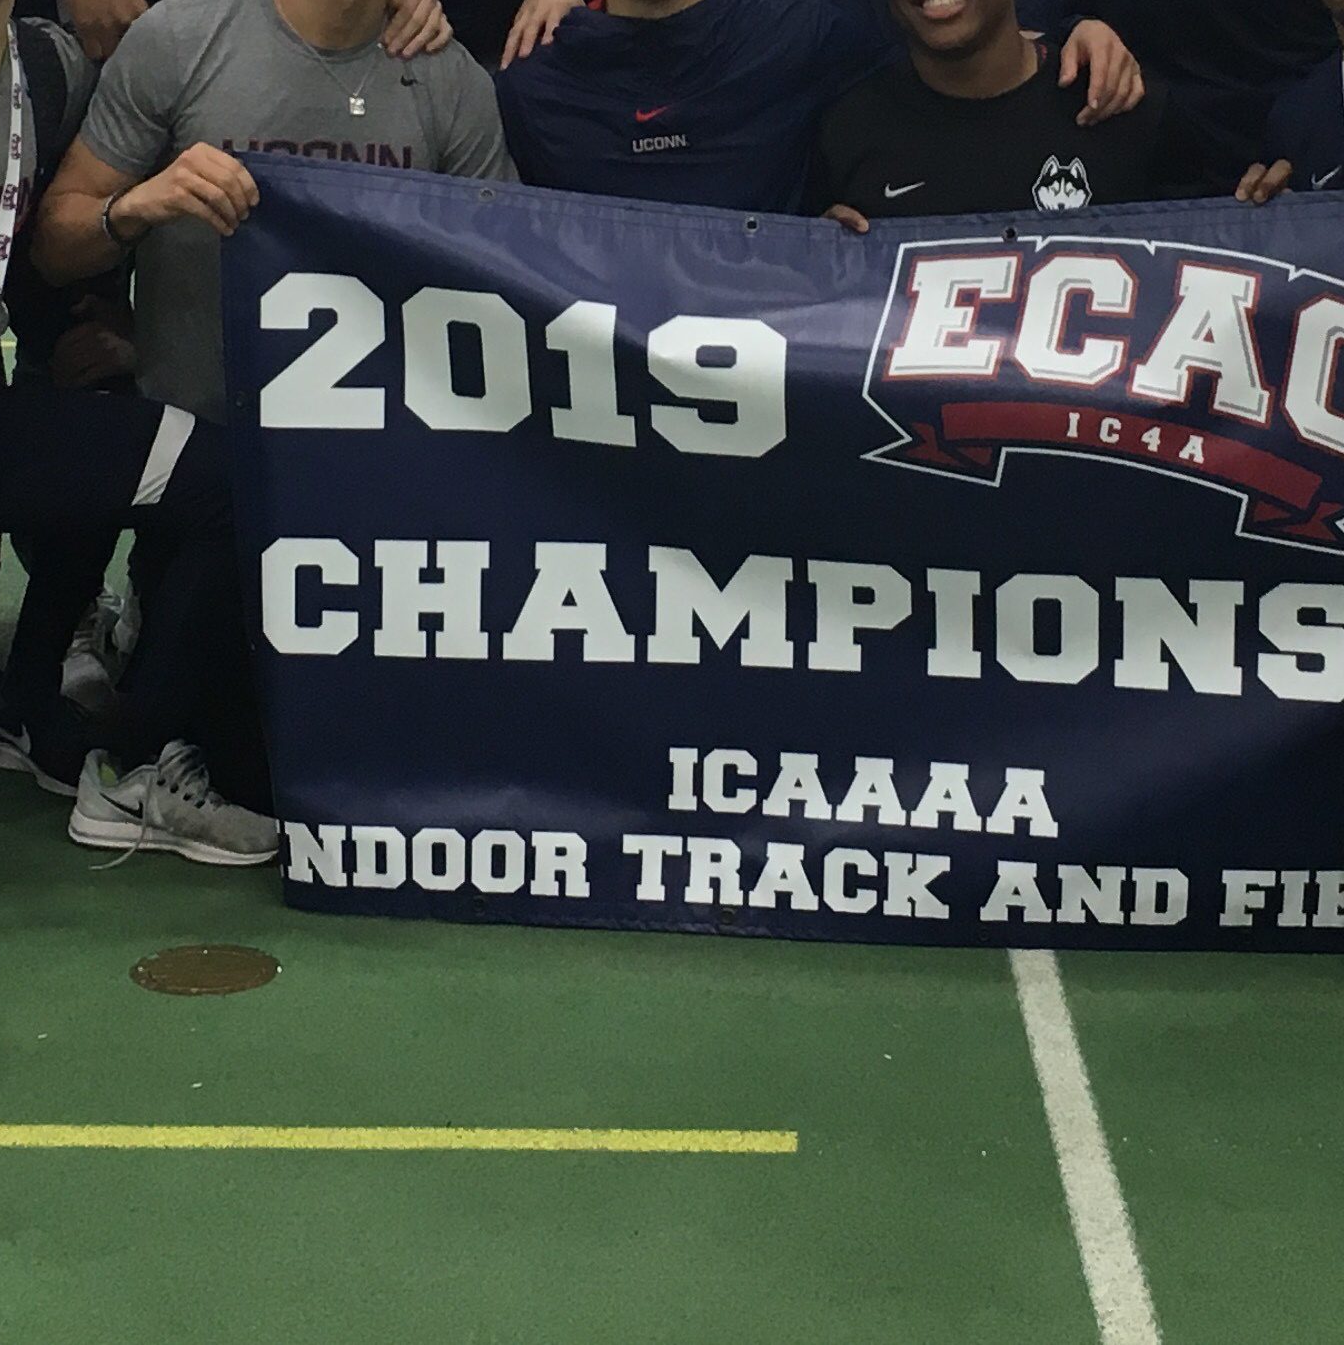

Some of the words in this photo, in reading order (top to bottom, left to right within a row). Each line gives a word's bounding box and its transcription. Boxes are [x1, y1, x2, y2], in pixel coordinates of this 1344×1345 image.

[632, 134, 688, 153] UCONN
[260, 272, 787, 457] 2019
[1066, 412, 1205, 464] IC4A
[668, 747, 1059, 838] ICAAAA
[278, 820, 590, 899] NDOOR
[622, 834, 951, 920] TRACK
[979, 860, 1189, 926] AND
